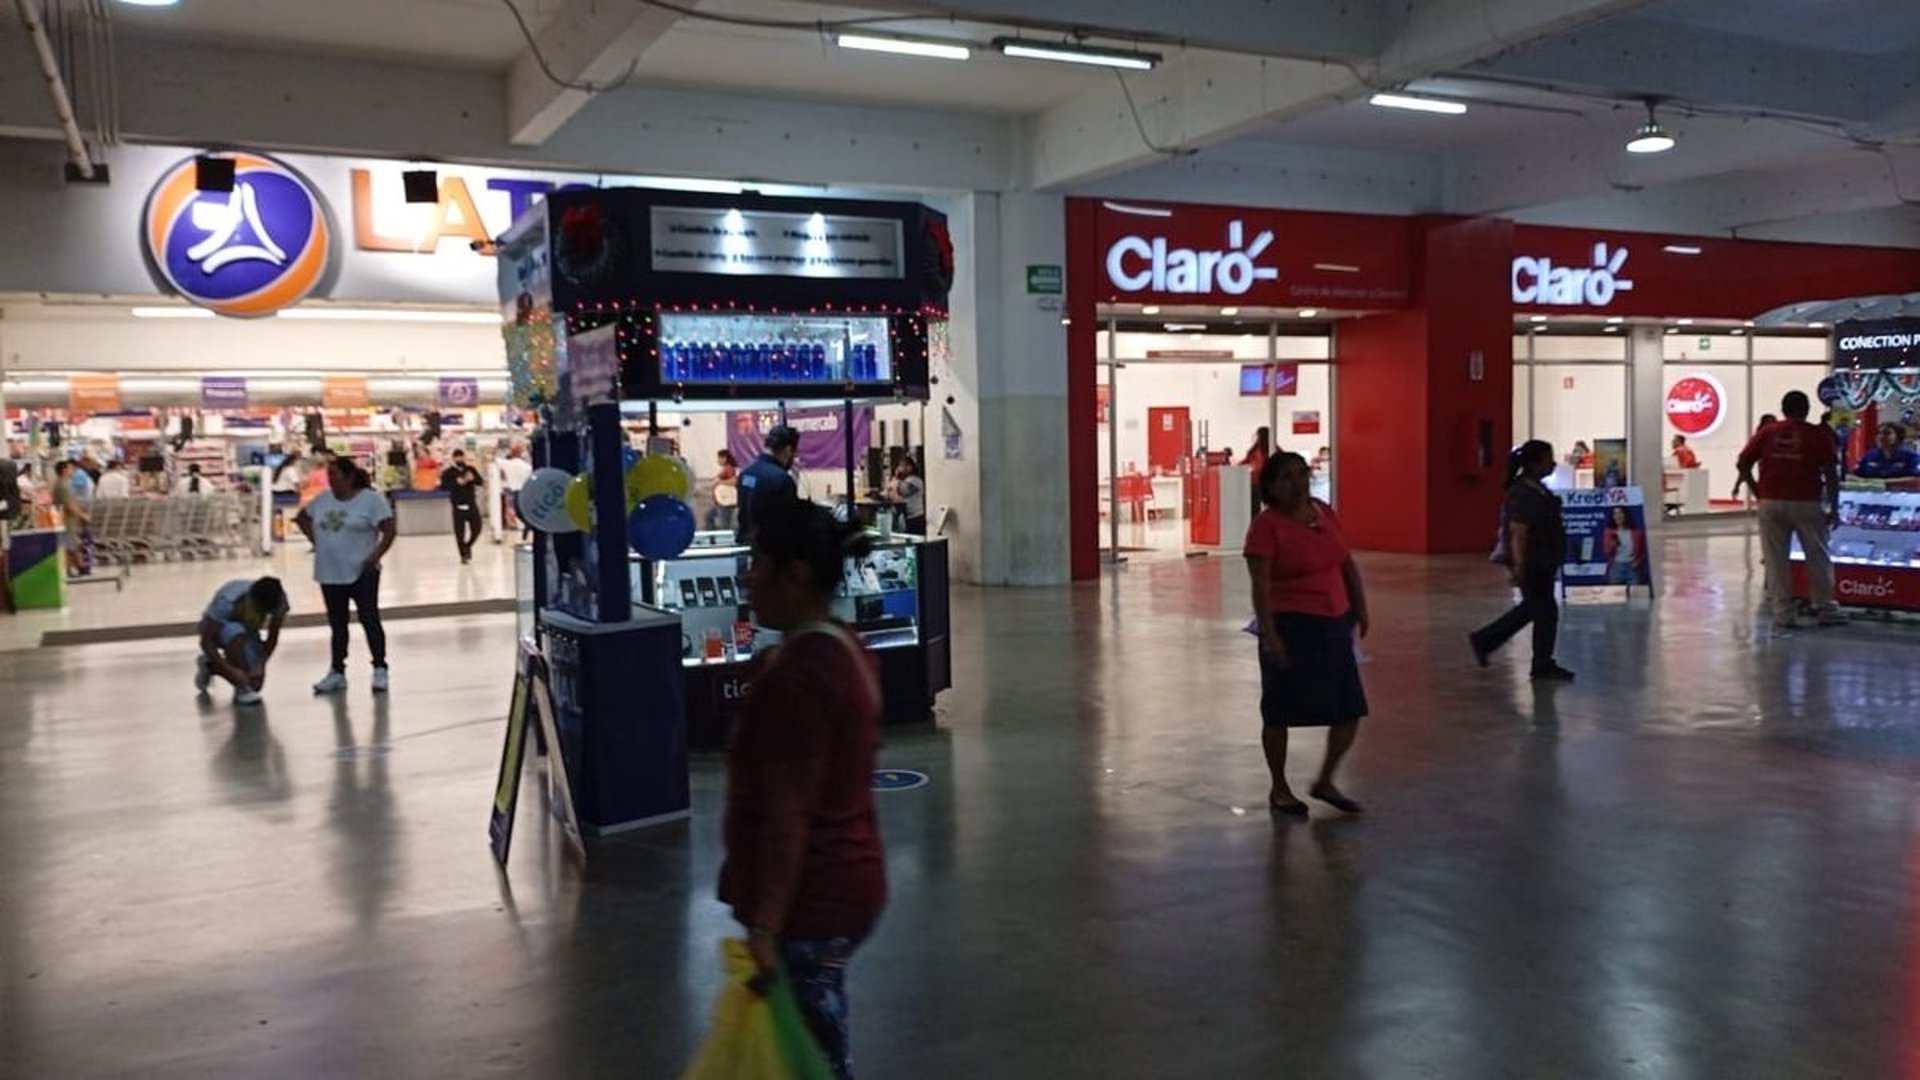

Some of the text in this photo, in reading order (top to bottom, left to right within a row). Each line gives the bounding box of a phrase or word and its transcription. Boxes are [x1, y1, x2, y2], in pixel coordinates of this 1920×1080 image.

[350, 169, 596, 256] LAT
[1106, 233, 1256, 295] Claro
[1511, 253, 1616, 306] Claro
[1839, 579, 1887, 597] Claro
